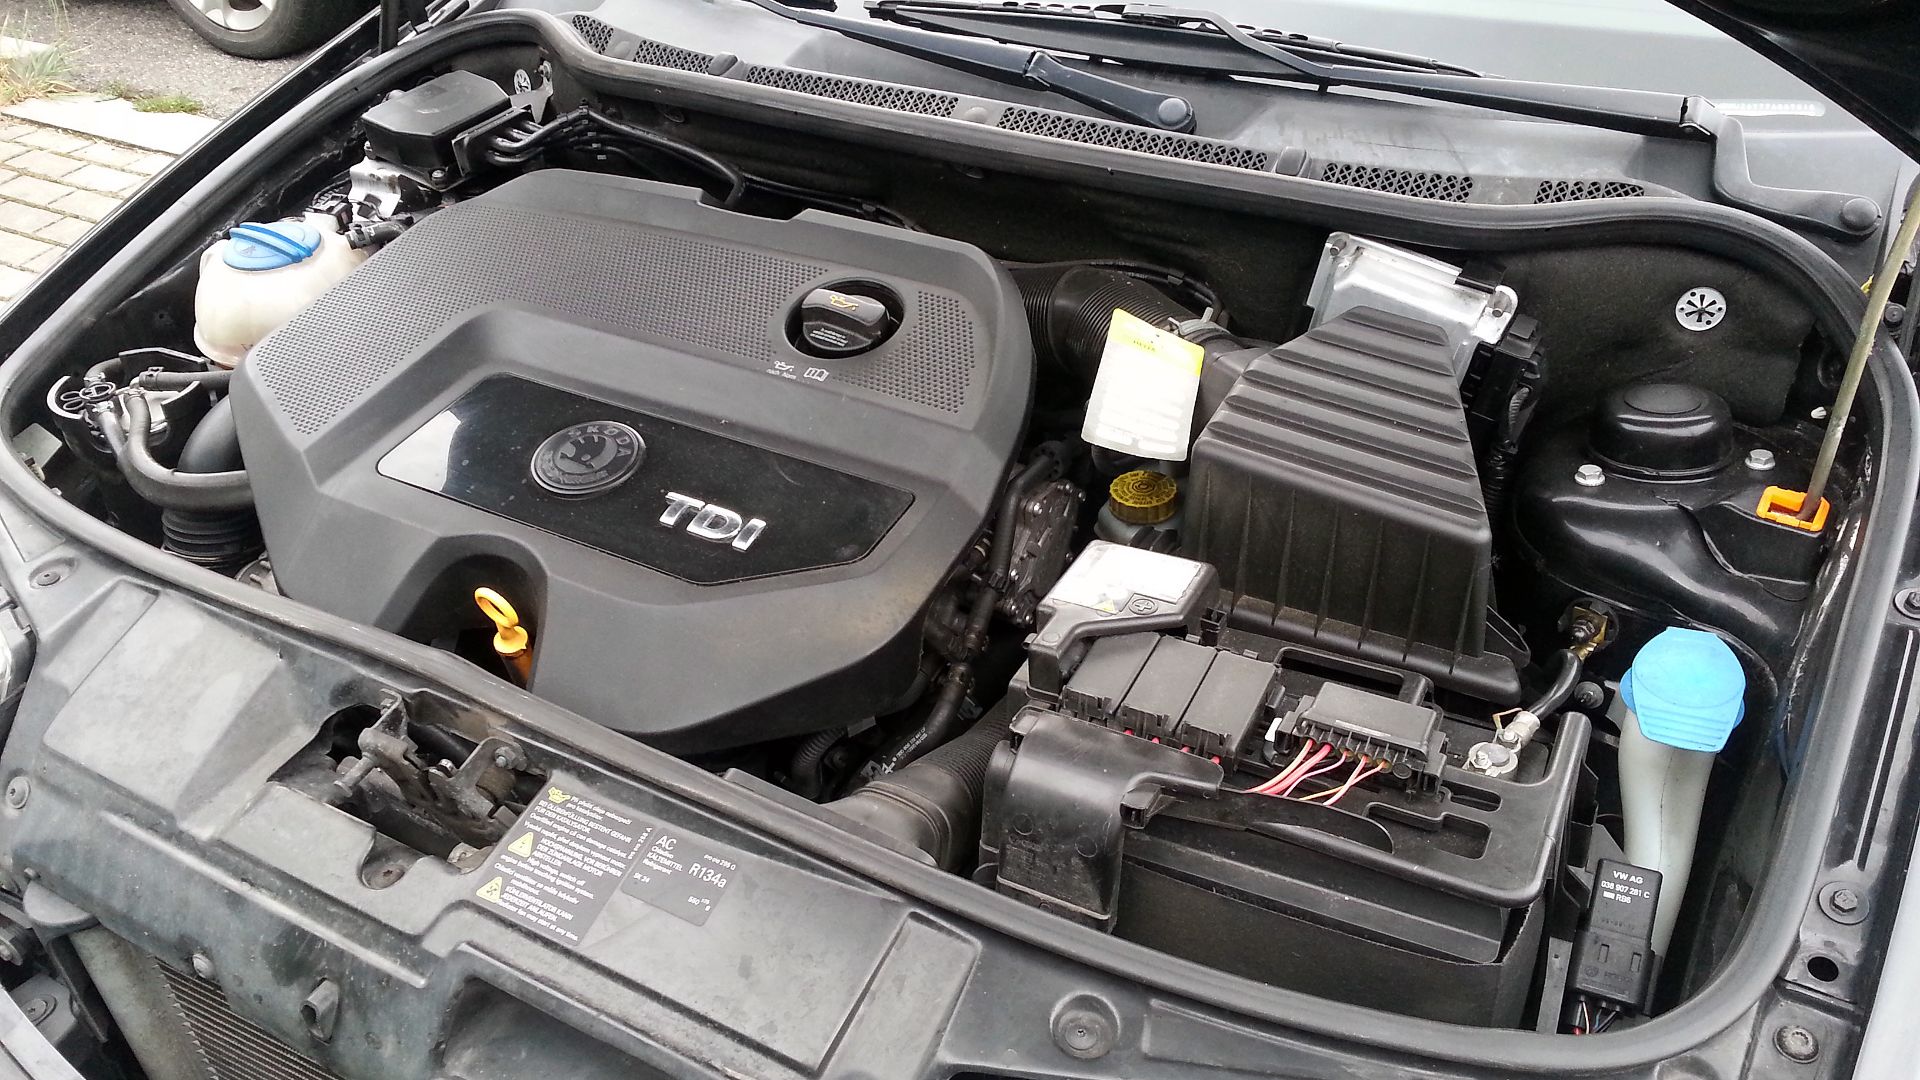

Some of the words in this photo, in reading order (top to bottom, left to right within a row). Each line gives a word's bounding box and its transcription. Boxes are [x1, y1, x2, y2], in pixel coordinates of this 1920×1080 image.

[659, 491, 767, 553] TDI
[545, 810, 557, 818] DEN
[552, 823, 570, 833] engine
[586, 838, 607, 849] damage
[610, 831, 632, 843] GEFAHR
[656, 835, 677, 850] AC
[517, 861, 534, 872] before
[582, 864, 603, 877] MOTOR
[688, 862, 727, 888] R134a
[1613, 870, 1629, 881] VW
[1629, 875, 1644, 884] AG
[1601, 880, 1615, 890] 038
[1615, 884, 1629, 893] 907
[1629, 888, 1643, 897] 281
[1643, 891, 1651, 899] C
